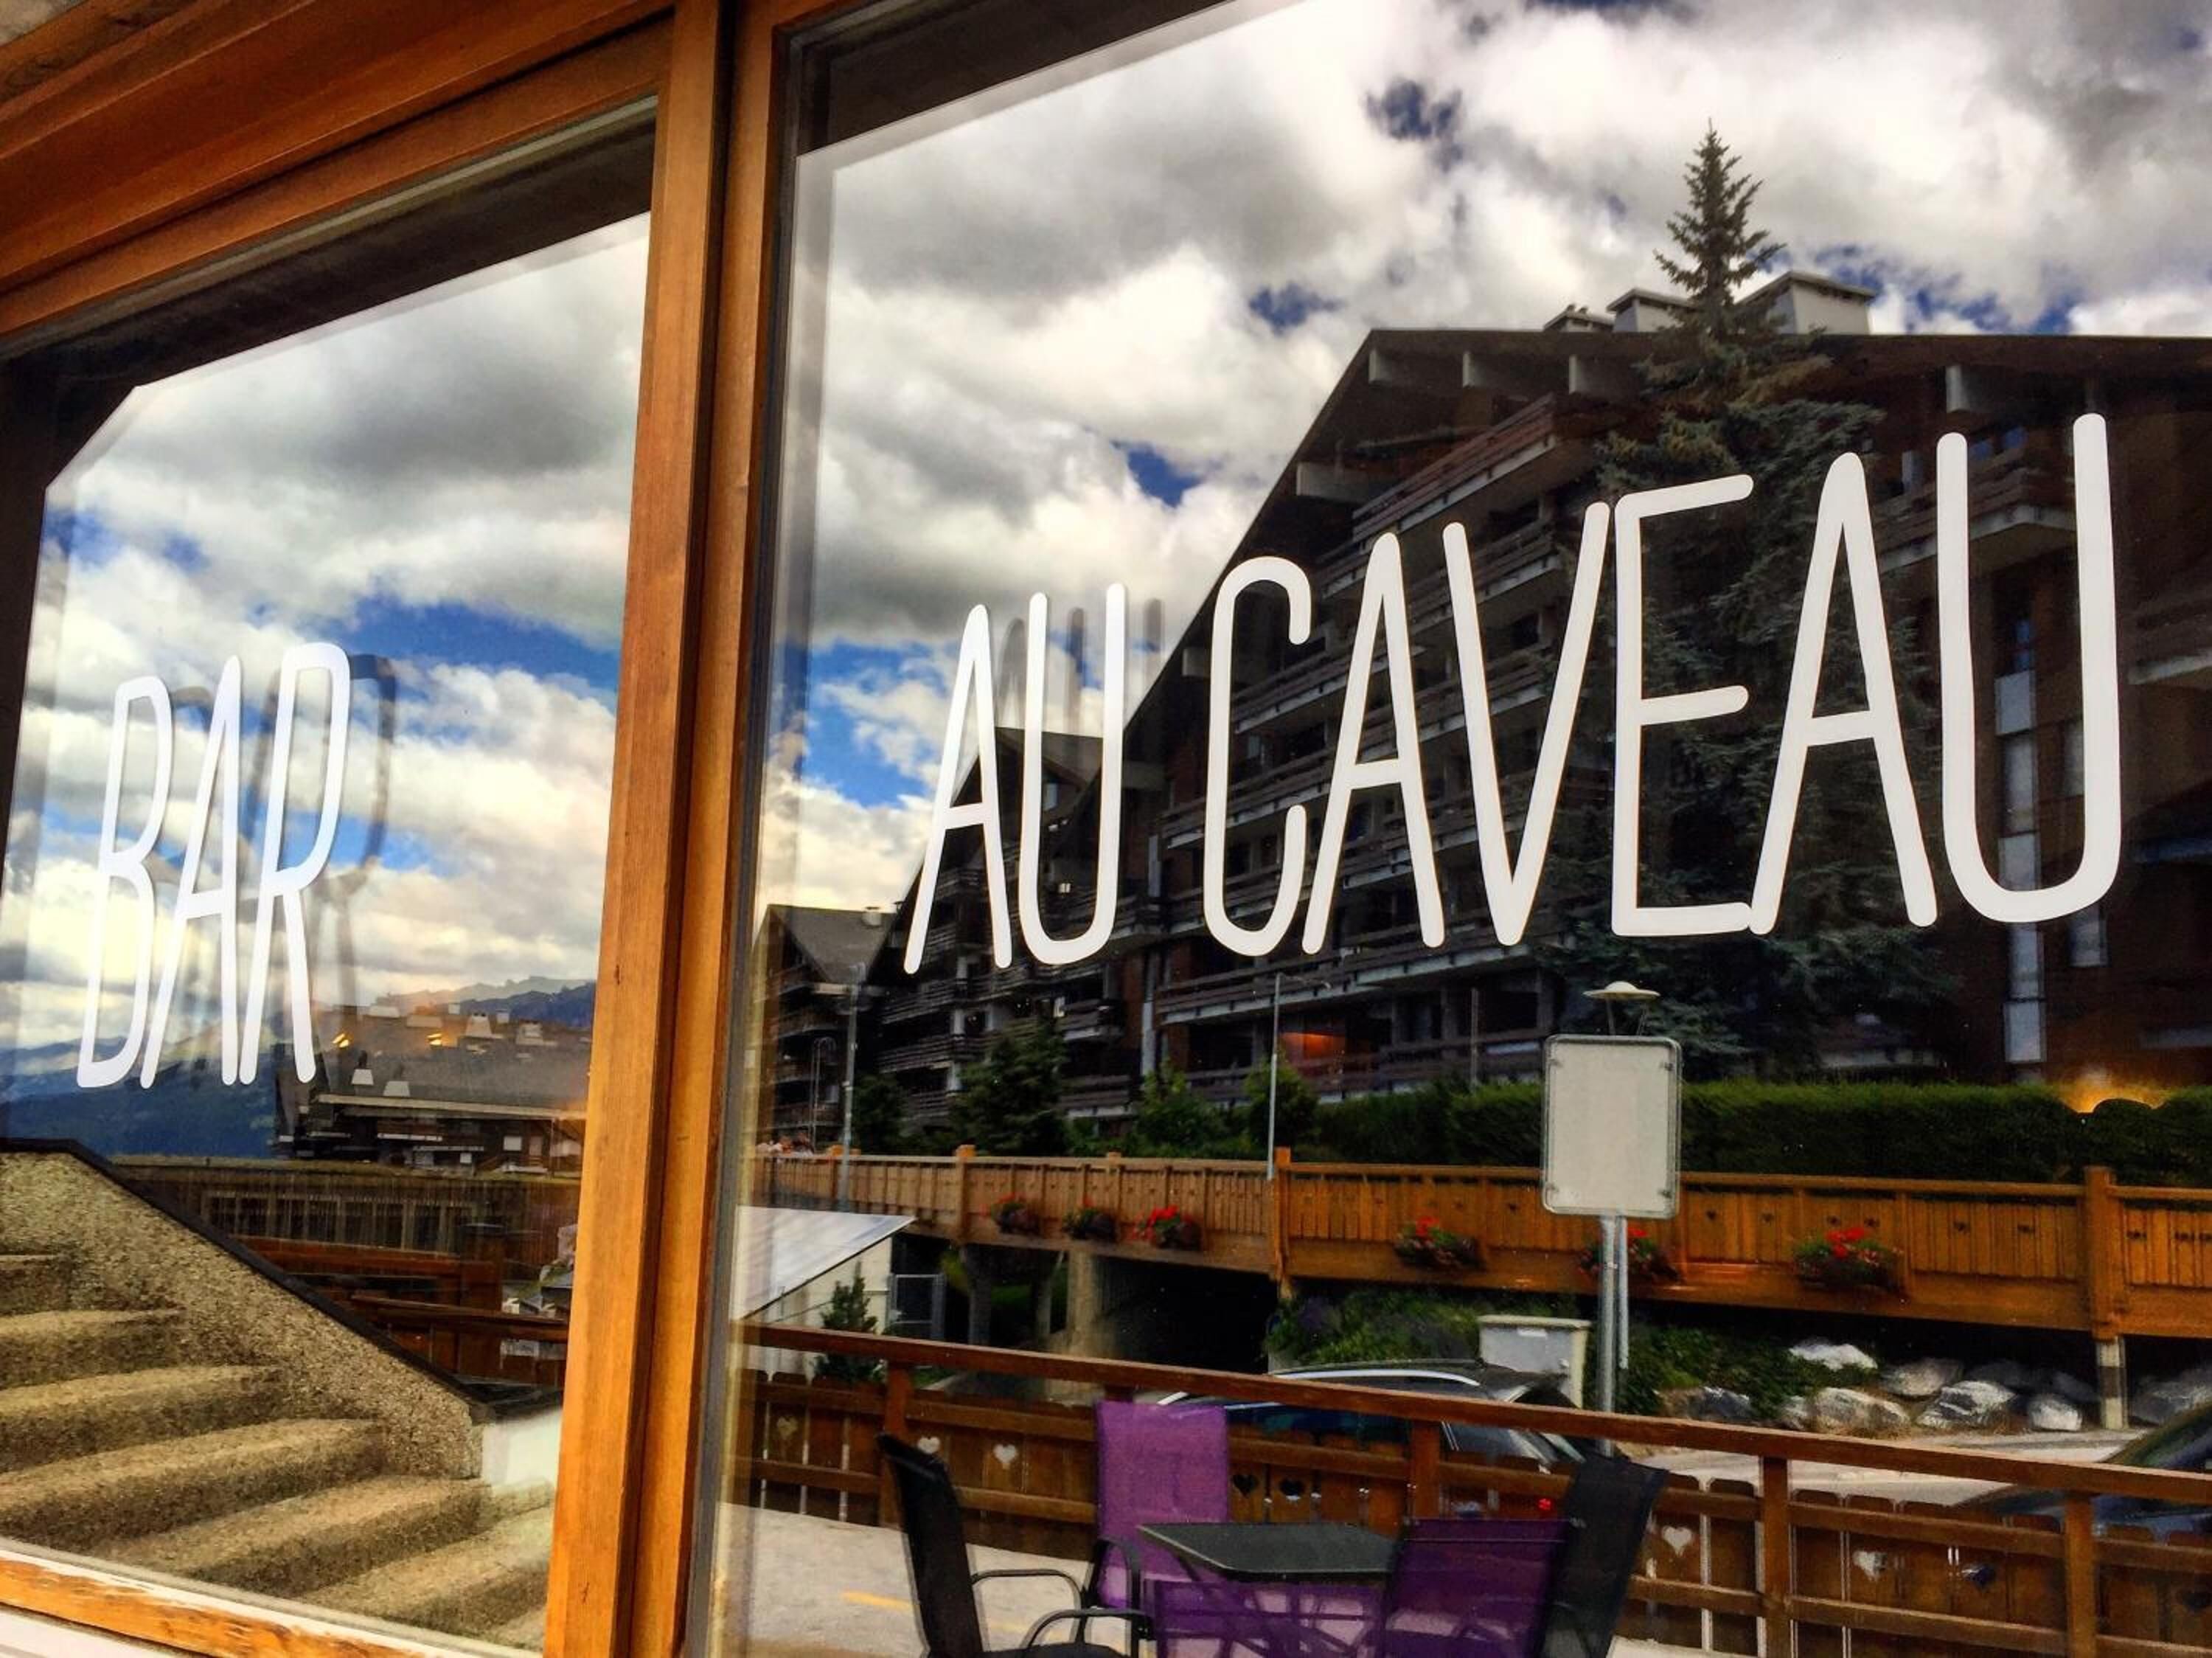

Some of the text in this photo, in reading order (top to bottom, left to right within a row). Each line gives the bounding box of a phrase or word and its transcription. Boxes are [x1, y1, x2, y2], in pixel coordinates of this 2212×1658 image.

[76, 642, 351, 1089] BAR
[903, 412, 2122, 975] AU CAVEAU
